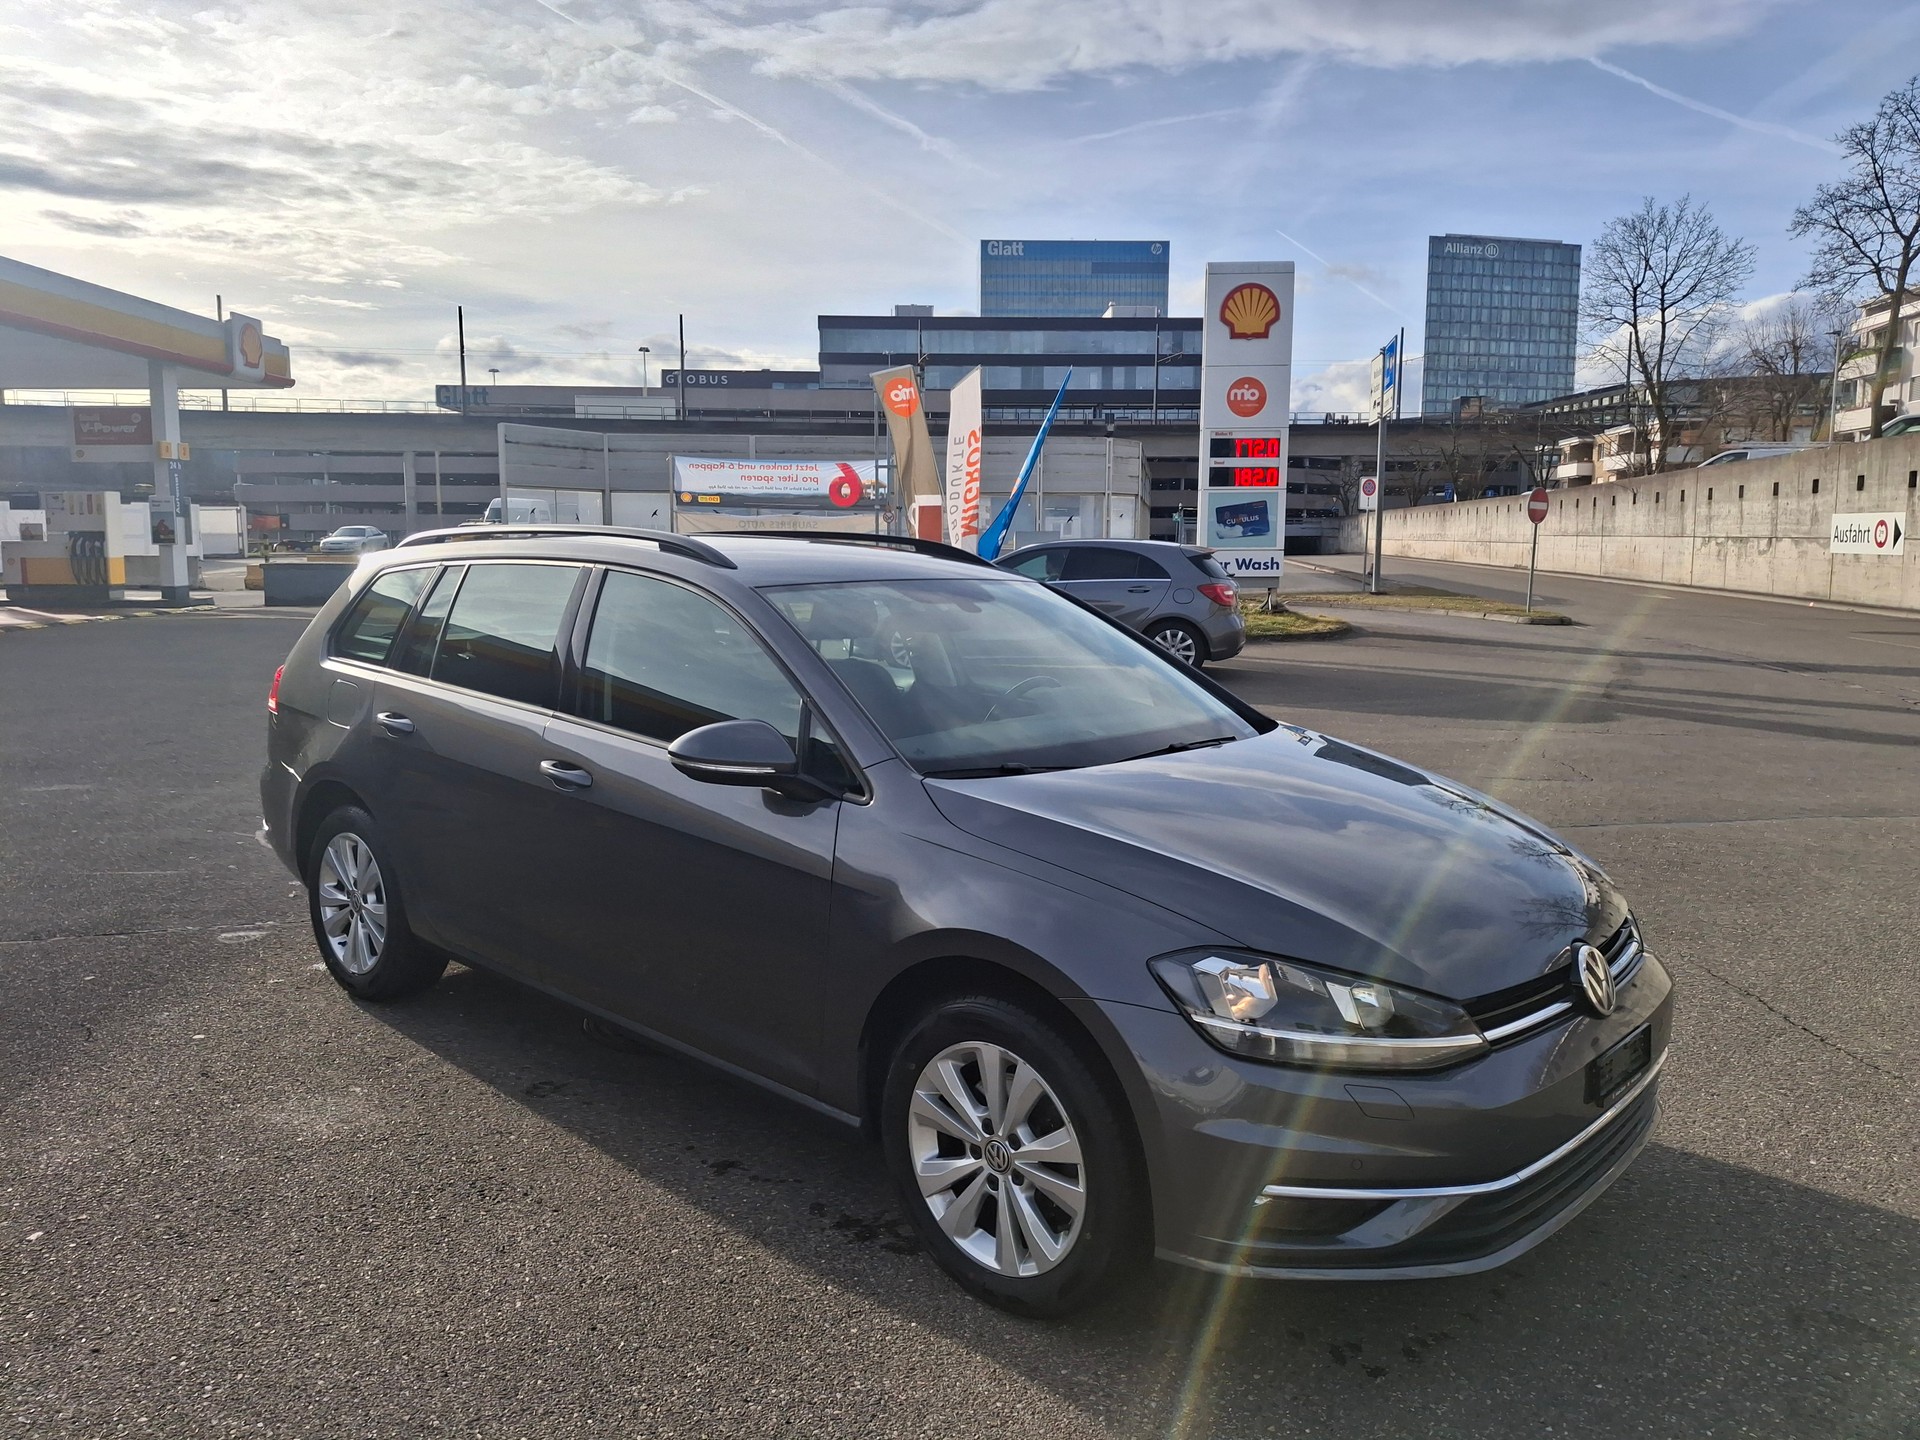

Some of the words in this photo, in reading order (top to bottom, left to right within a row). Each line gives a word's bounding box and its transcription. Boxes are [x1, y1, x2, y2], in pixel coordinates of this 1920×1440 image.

[987, 240, 1025, 256] Glatt
[1444, 242, 1483, 255] Allianz
[1230, 383, 1260, 401] mio
[80, 421, 137, 434] V-Power
[1833, 523, 1871, 543] Ausfahrt
[1234, 556, 1280, 571] Wash
